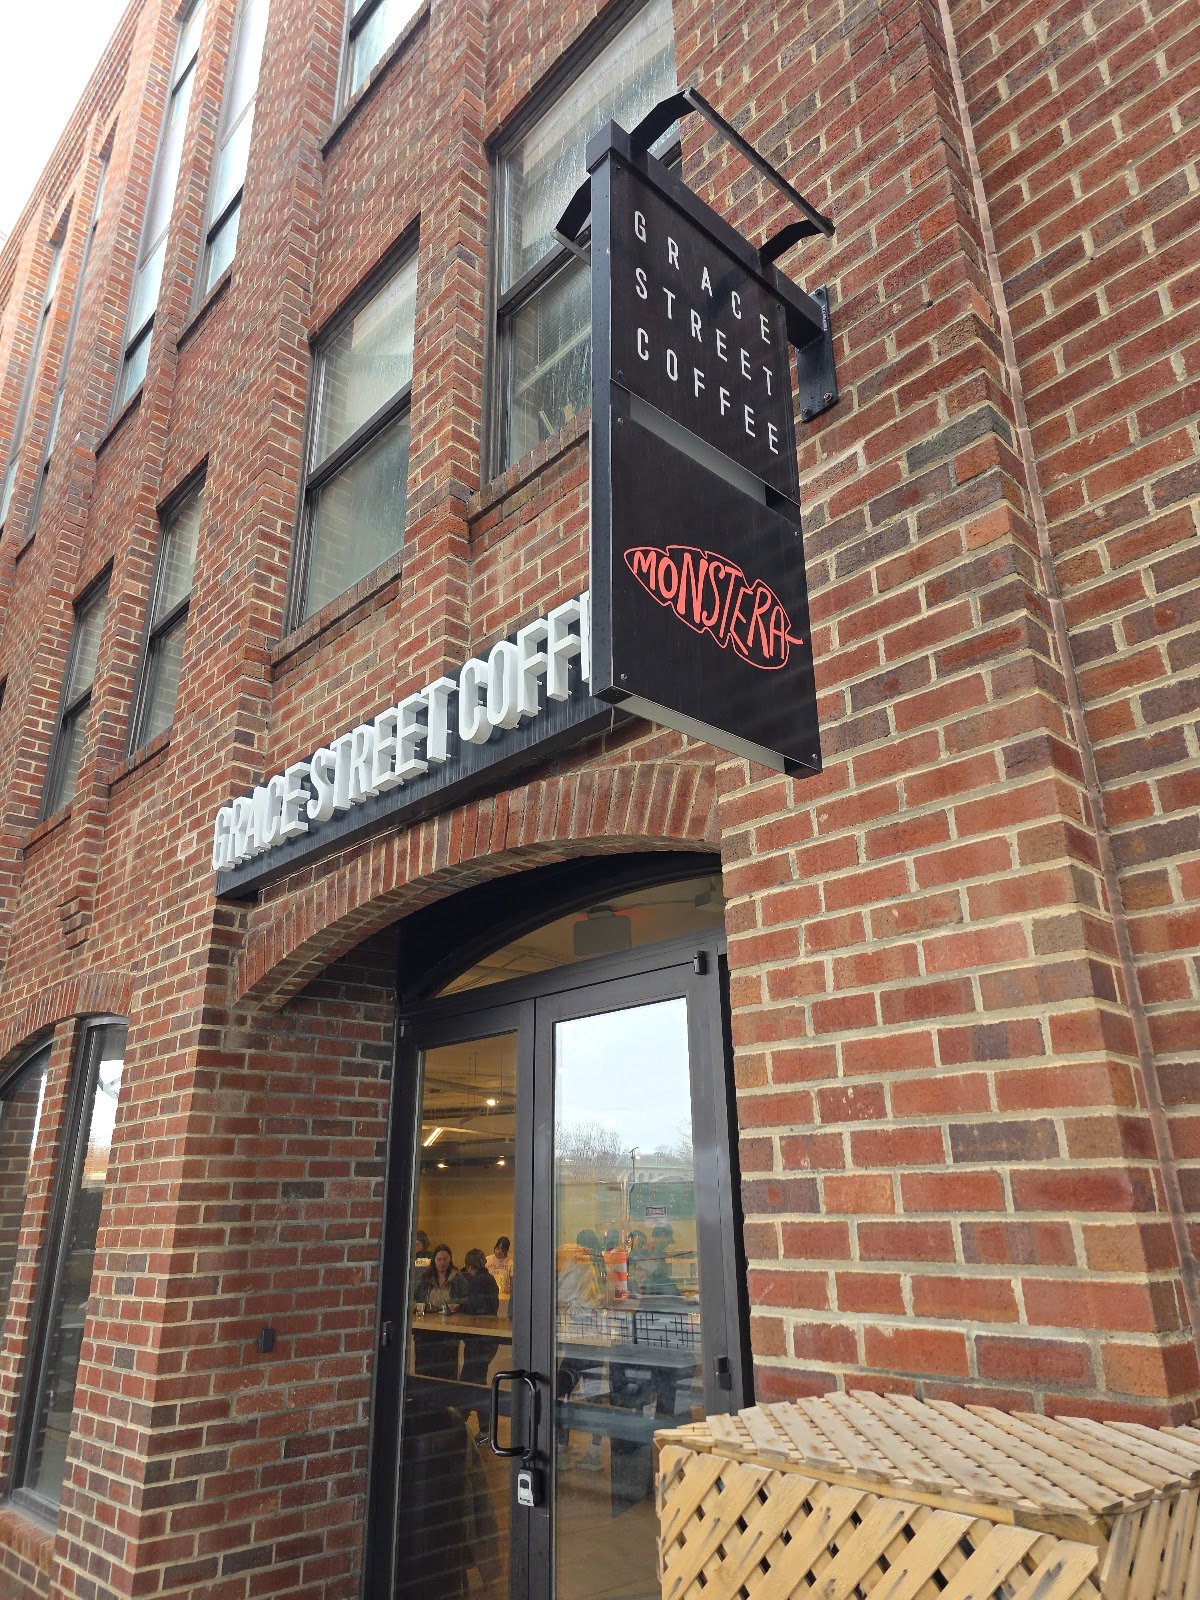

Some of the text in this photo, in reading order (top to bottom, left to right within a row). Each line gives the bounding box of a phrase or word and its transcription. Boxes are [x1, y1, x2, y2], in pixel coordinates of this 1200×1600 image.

[634, 210, 771, 345] GRACE
[635, 267, 773, 396] STREET
[636, 327, 779, 455] COFFEE
[633, 550, 803, 660] MONSTERA
[211, 590, 590, 873] GRACE STREET COFF
